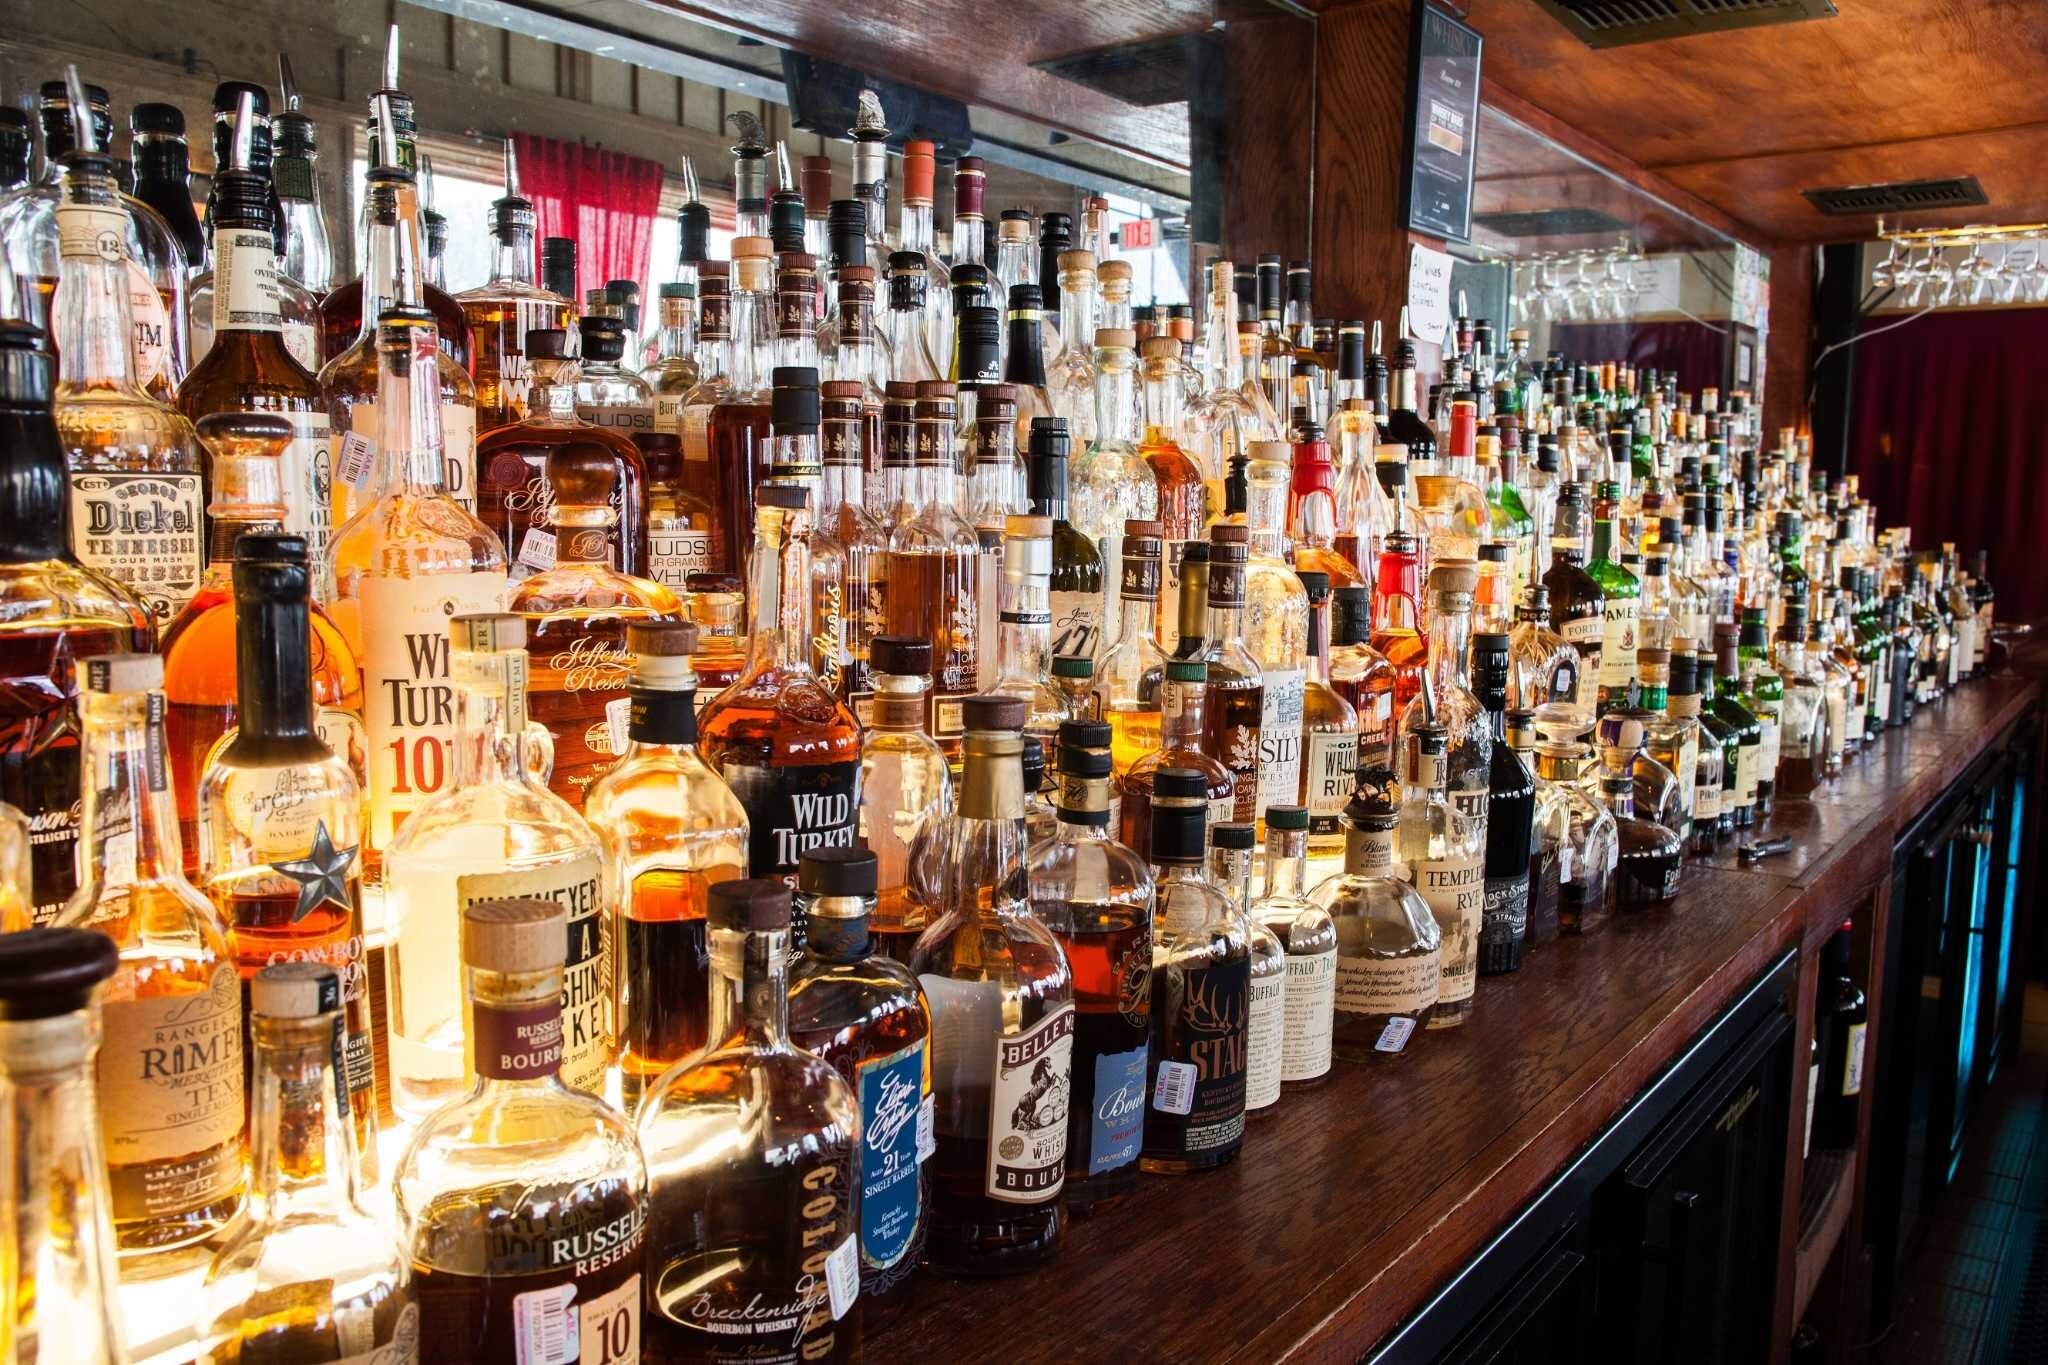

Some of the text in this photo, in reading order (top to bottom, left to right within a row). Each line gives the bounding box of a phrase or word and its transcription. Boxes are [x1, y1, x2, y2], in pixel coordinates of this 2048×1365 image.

[100, 239, 120, 253] 12
[84, 499, 195, 537] Dickel
[86, 538, 195, 555] TENNESSEE
[110, 556, 182, 565] SOUR MASH
[666, 557, 697, 567] GRAIN
[1361, 732, 1385, 745] CREEK
[791, 793, 849, 830] WILD
[772, 823, 855, 866] TURKEY
[581, 924, 592, 961] A
[1442, 966, 1466, 978] SMALL
[1007, 1020, 1062, 1065] BELLE
[864, 1161, 916, 1200] SINGLE BARREL
[883, 1150, 900, 1178] 21
[575, 1226, 645, 1278] RESERVE
[691, 1274, 828, 1349] Breckenridge
[706, 1317, 799, 1335] BOURBON WHISKEY
[596, 1306, 630, 1365] 10
